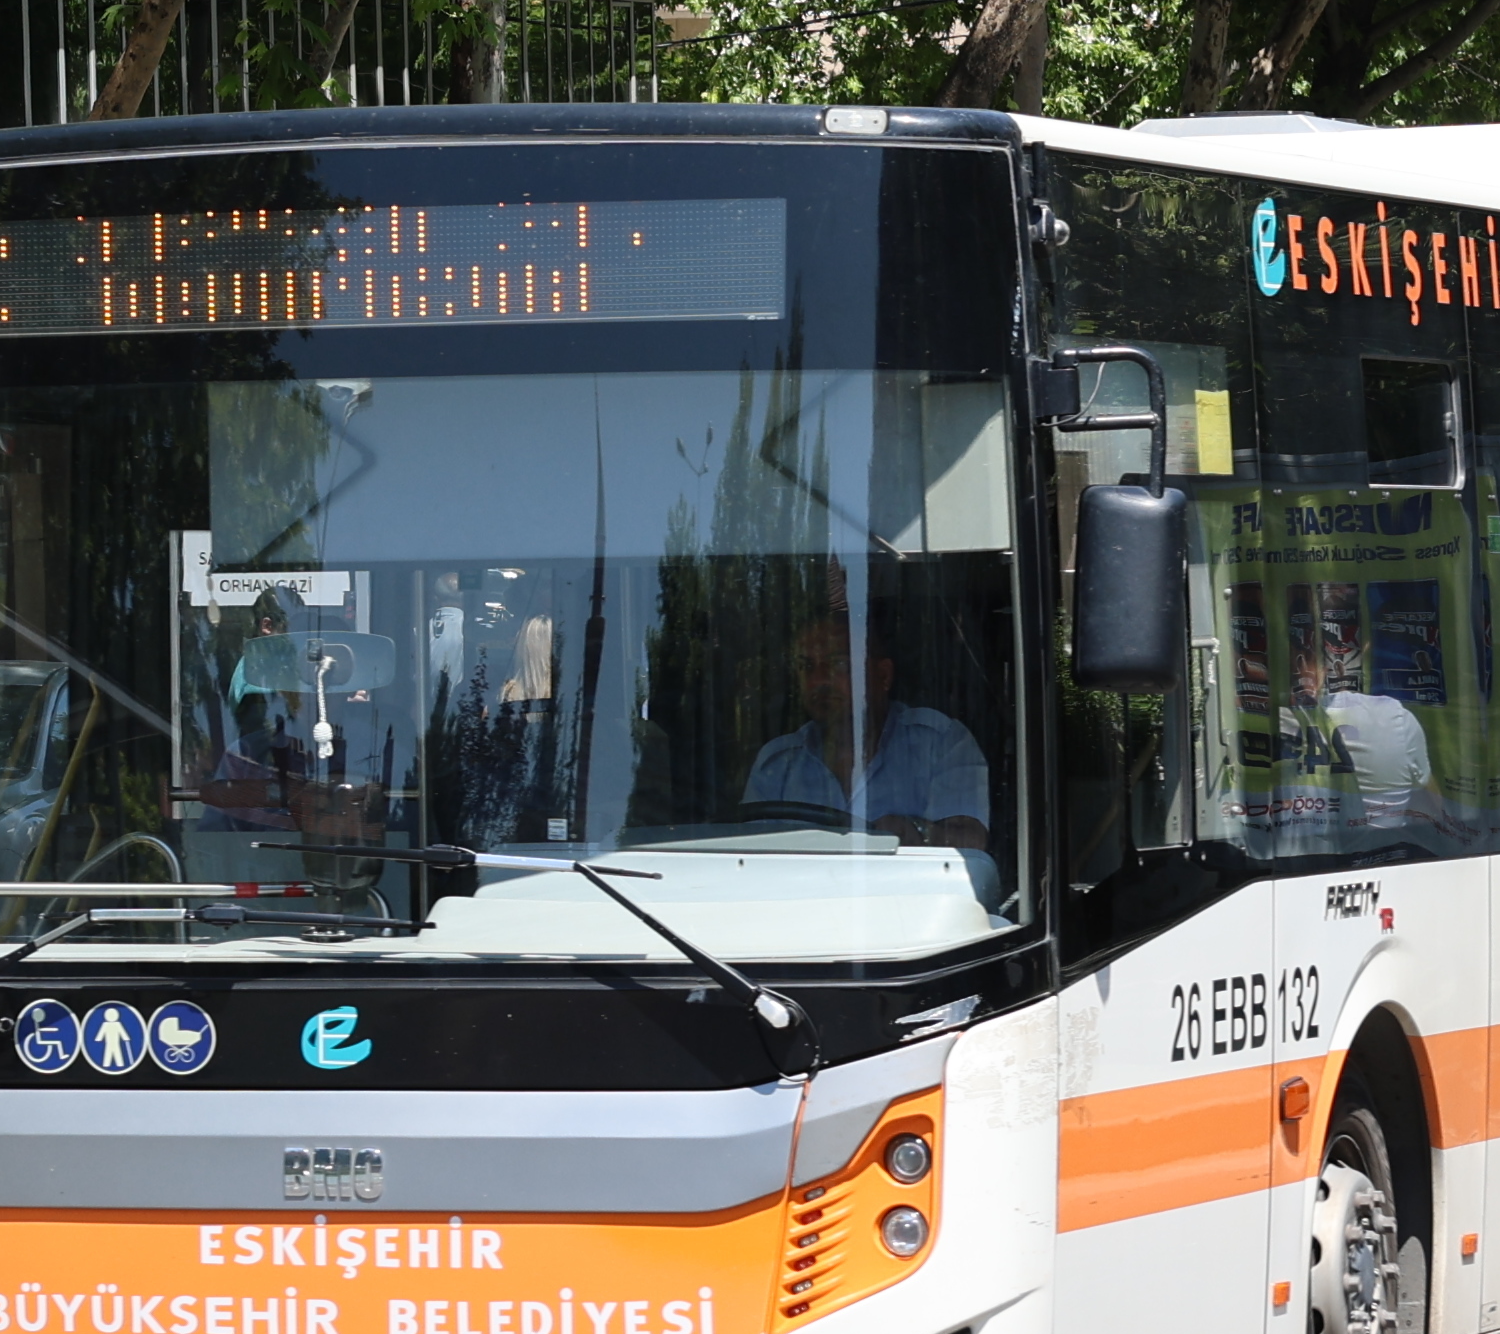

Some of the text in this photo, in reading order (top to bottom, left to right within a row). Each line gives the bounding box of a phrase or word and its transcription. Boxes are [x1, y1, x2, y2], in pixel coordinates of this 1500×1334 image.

[1170, 964, 1320, 1063] 26 EBB 132
[284, 1147, 384, 1202] BMC
[200, 1215, 503, 1279] ESKİŞEHİR
